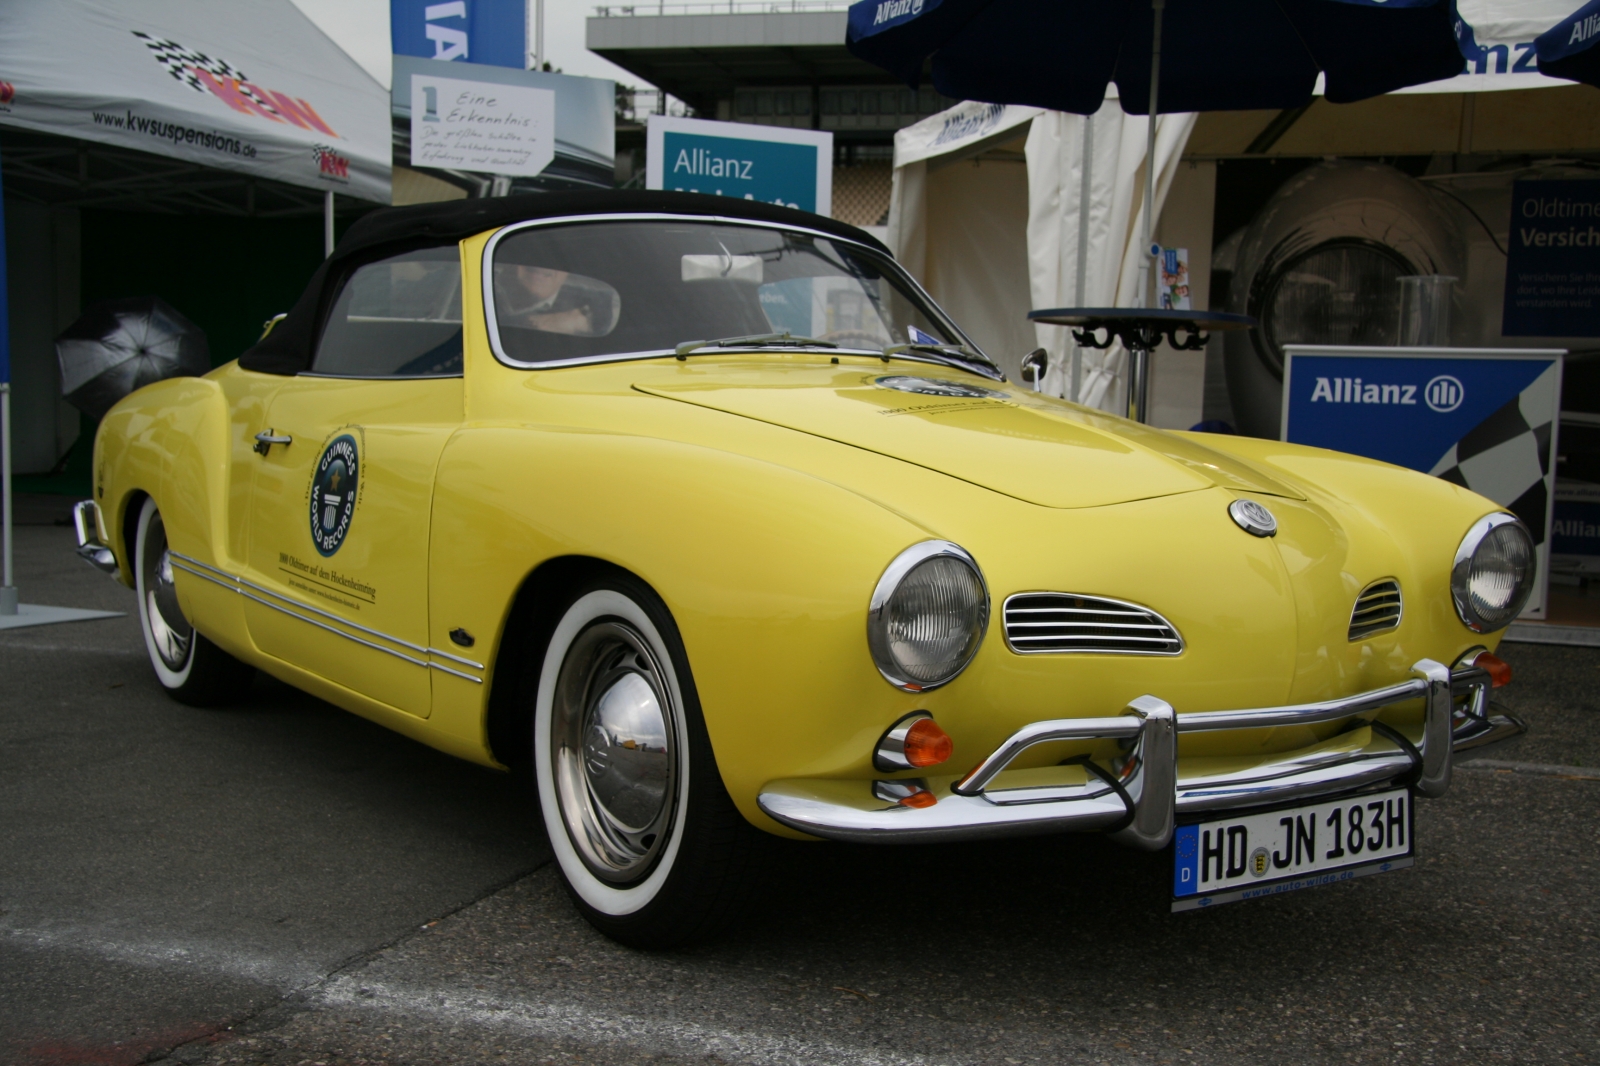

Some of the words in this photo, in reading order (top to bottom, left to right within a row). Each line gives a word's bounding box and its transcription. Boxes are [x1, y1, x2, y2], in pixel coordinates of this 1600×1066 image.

[873, 0, 912, 26] Allianz
[1461, 42, 1538, 75] nz
[456, 91, 498, 107] Eine
[92, 110, 257, 158] www.kwsuspensions.de
[674, 148, 754, 180] Allianz
[1310, 377, 1417, 405] Allianz
[321, 441, 356, 476] GUINNESS
[312, 485, 323, 543] WORLD
[323, 490, 354, 550] RECORDS
[330, 570, 376, 600] Hockenheimring
[1202, 825, 1248, 883] HD
[1272, 812, 1316, 869] JN
[1326, 797, 1404, 859] 183H
[1181, 867, 1191, 883] D
[1241, 870, 1354, 899] www.auto-wilde.de
